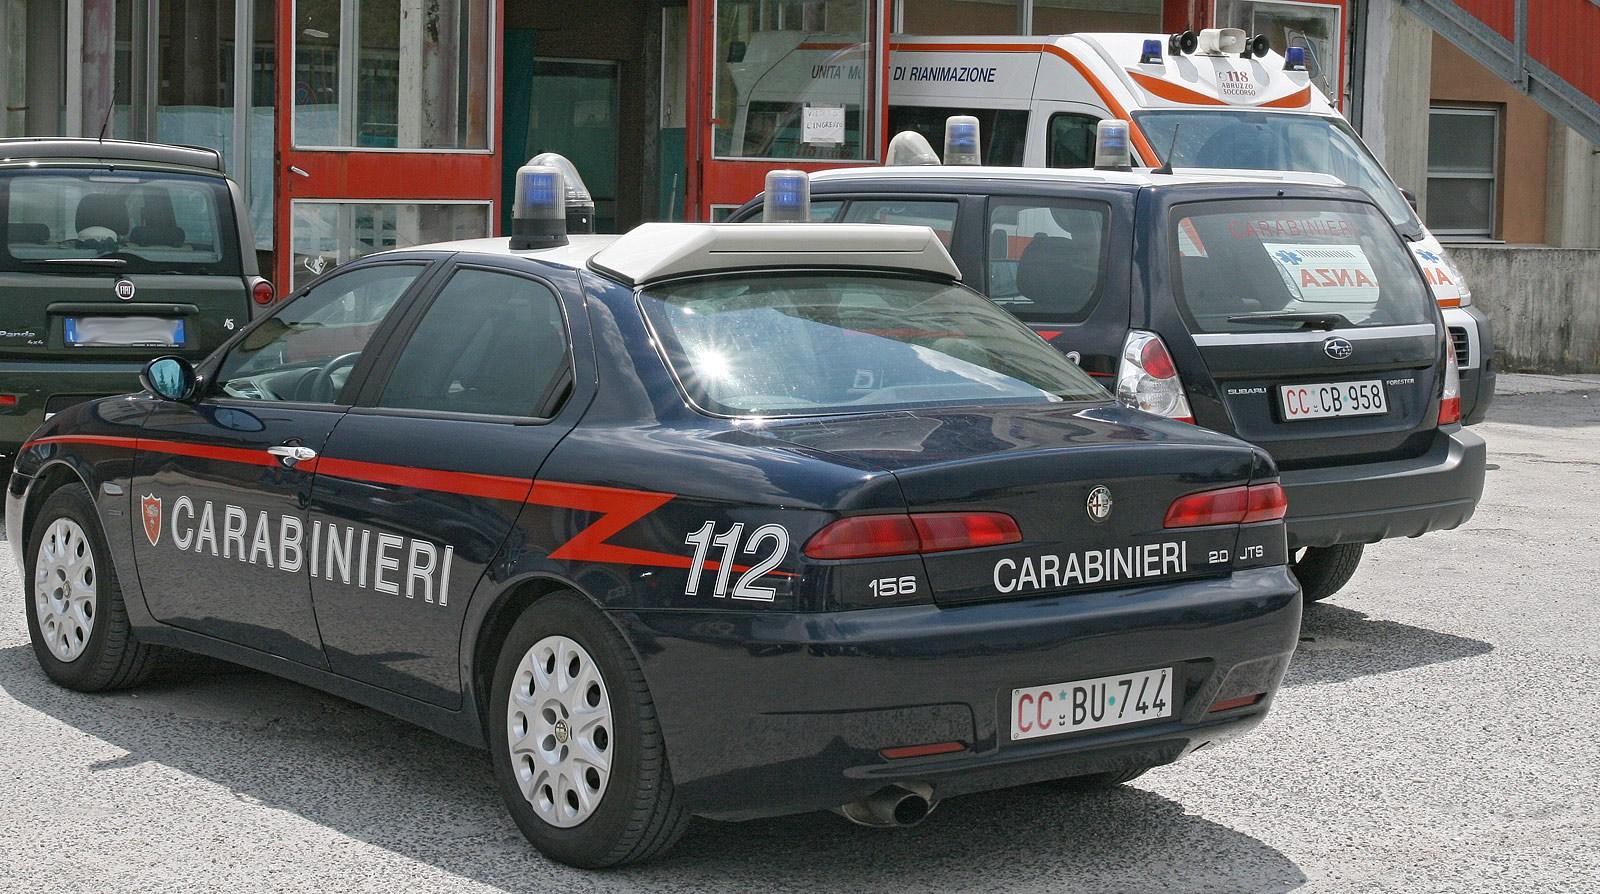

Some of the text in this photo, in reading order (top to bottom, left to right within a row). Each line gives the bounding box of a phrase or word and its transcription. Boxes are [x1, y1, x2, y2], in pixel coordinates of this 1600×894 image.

[893, 66, 906, 81] DI
[909, 66, 997, 83] RIANIMAZIONE
[1225, 71, 1249, 82] 118
[0, 330, 36, 338] Panda
[1227, 387, 1267, 395] SUBARU
[1386, 378, 1415, 386] FORESTER
[1286, 384, 1382, 415] CC CB 958
[171, 494, 455, 607] CARABINIERI
[1239, 544, 1264, 560] JTS
[684, 520, 790, 602] 112
[993, 540, 1188, 594] CARABINIERI
[868, 575, 918, 598] 156
[1017, 673, 1167, 733] CC BU 744
